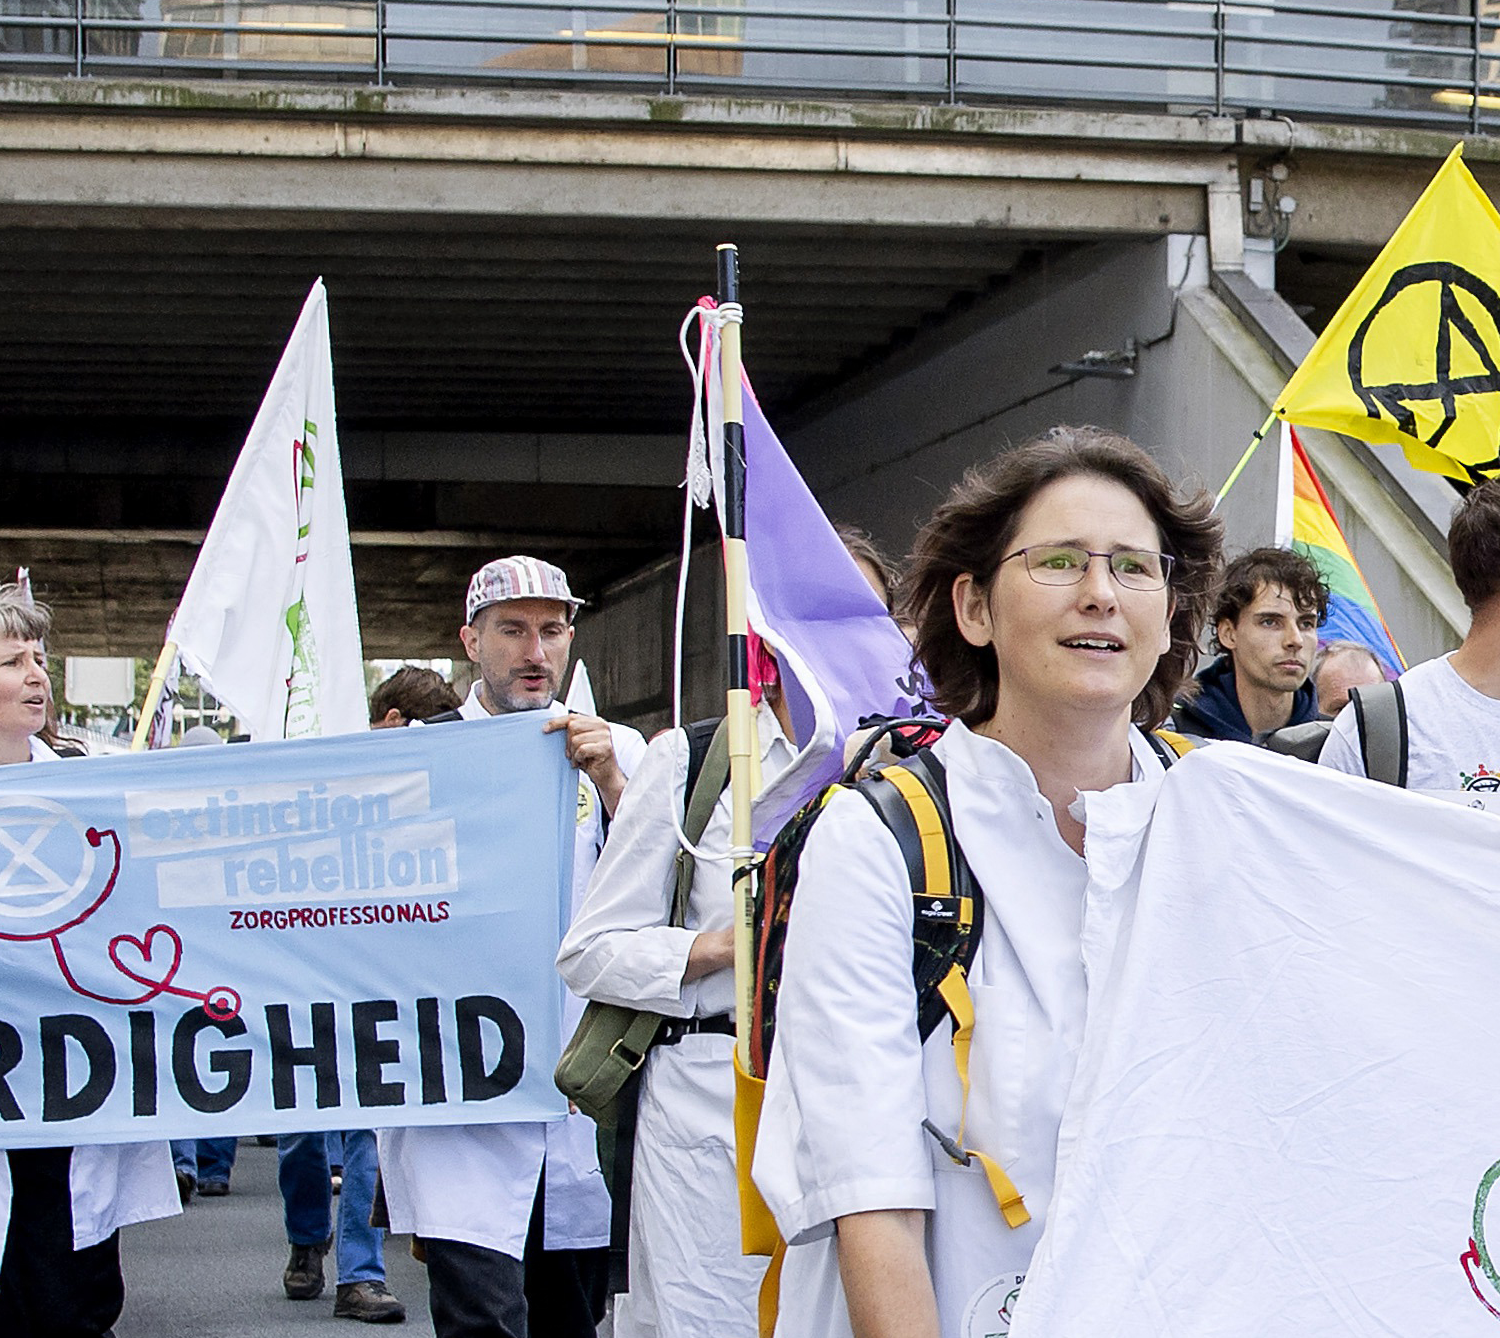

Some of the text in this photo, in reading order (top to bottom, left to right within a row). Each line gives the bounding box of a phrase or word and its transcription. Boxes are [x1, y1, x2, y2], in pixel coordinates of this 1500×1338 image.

[141, 781, 390, 841] extinction
[223, 827, 448, 898] rebellion
[230, 901, 450, 929] ZORGPROFESSIONALS
